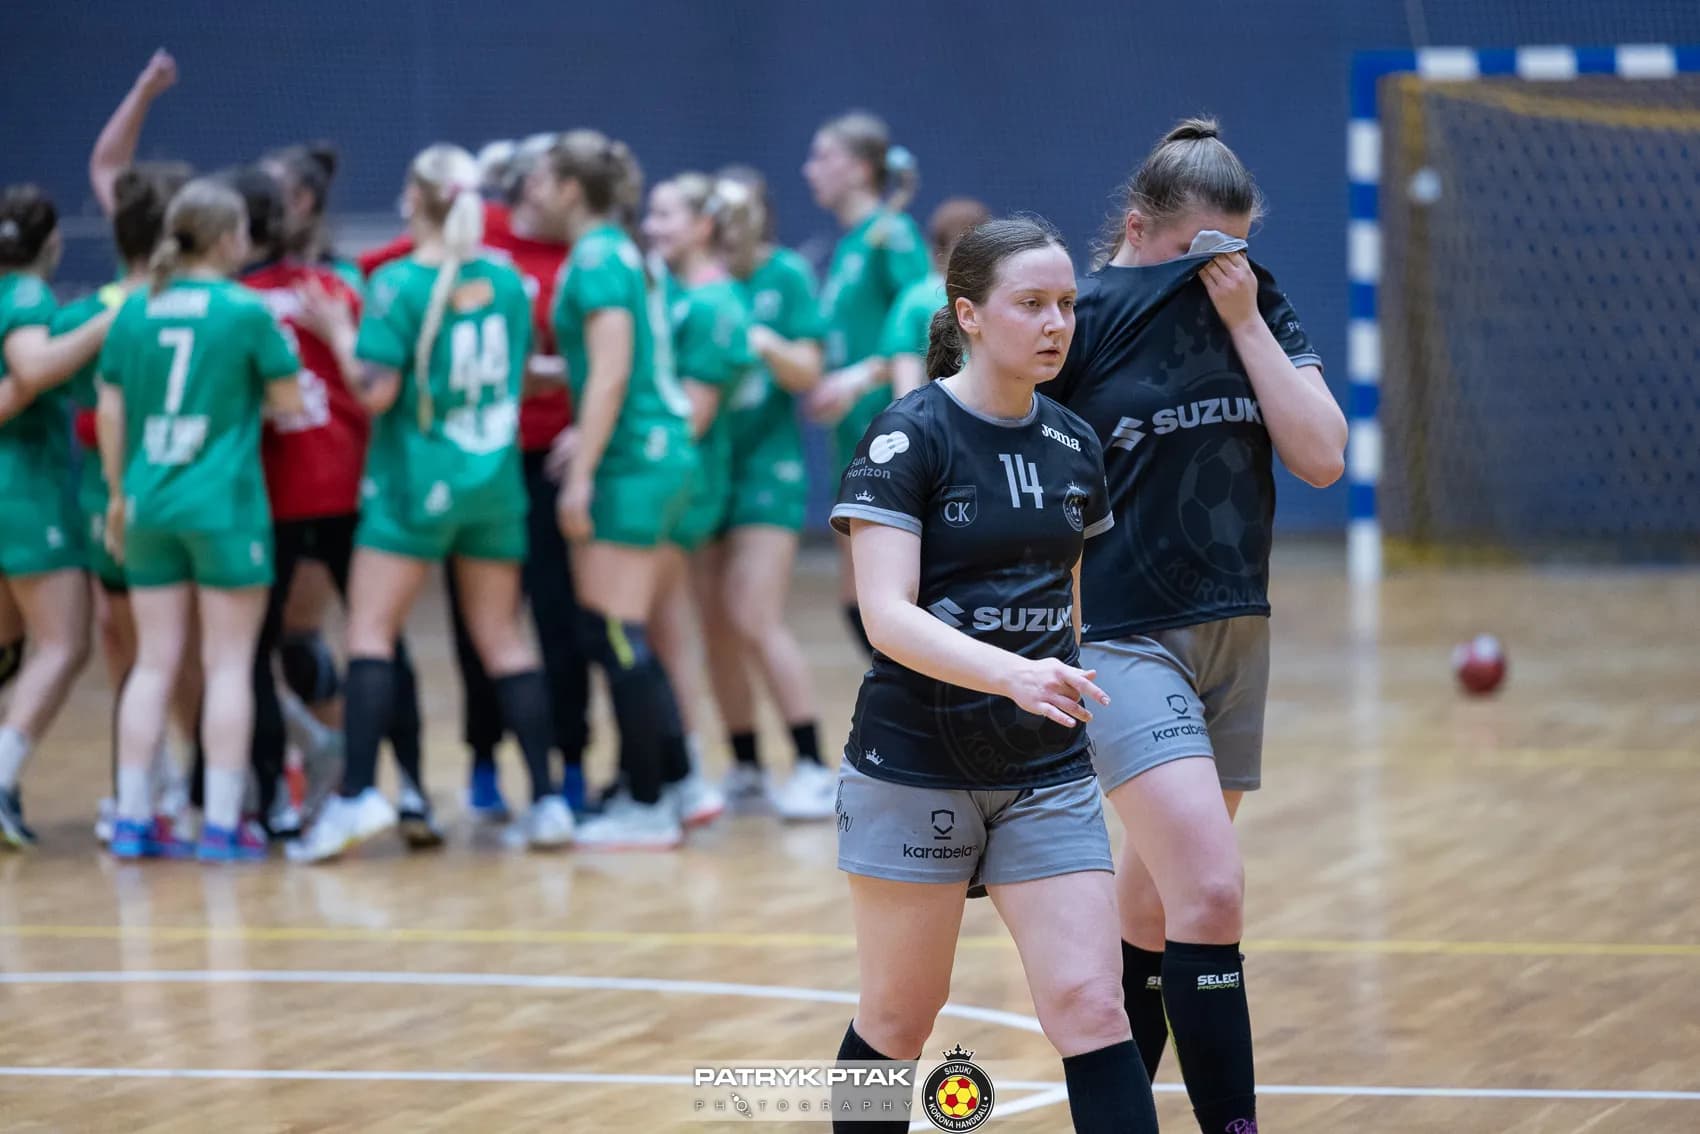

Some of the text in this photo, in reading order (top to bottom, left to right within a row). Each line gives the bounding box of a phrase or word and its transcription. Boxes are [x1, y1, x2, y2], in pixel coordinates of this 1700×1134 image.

[158, 327, 194, 414] 7
[1152, 396, 1263, 436] SUZUK
[846, 465, 891, 480] Horizon
[998, 453, 1044, 509] 14
[943, 501, 971, 522] CK
[972, 605, 1073, 632] SUZUK
[1151, 722, 1208, 743] karabe
[903, 843, 973, 859] karabela
[1197, 971, 1240, 986] SELECT
